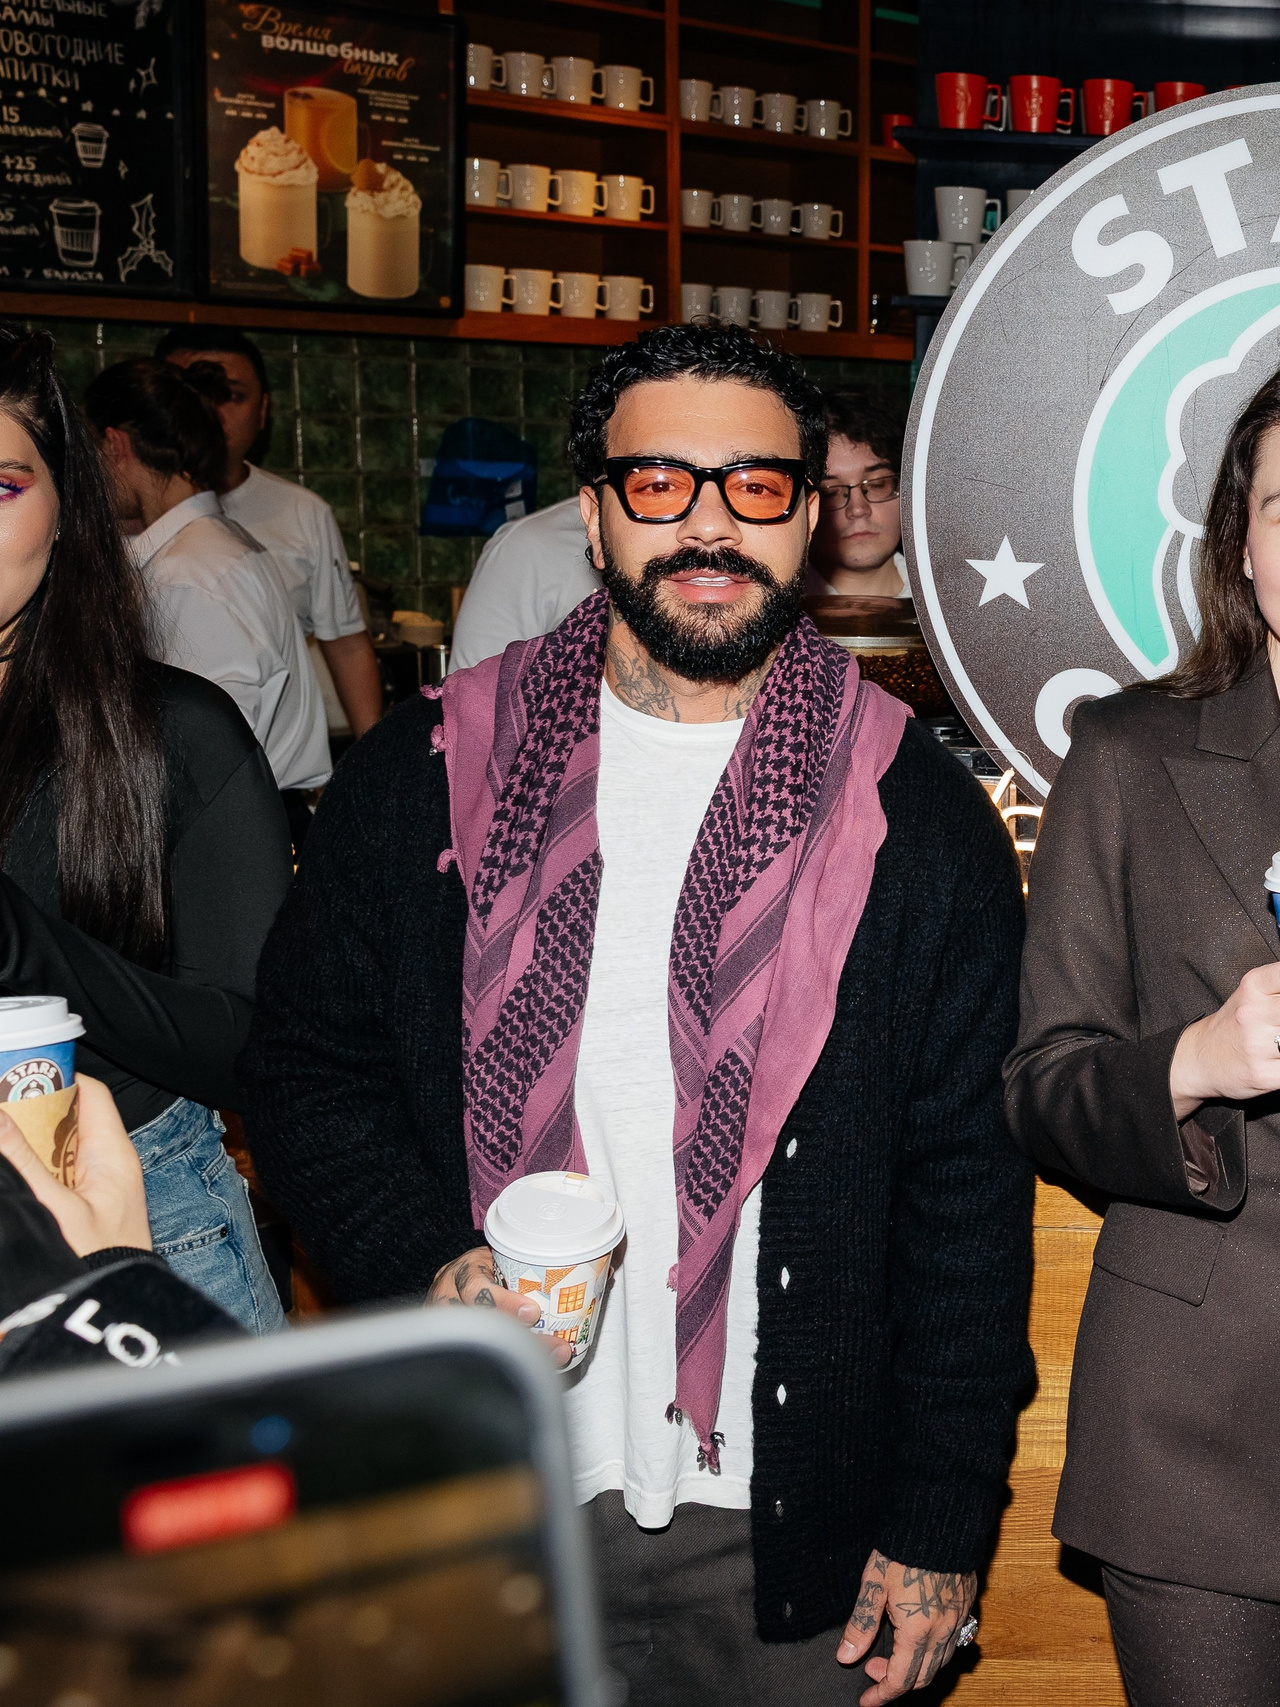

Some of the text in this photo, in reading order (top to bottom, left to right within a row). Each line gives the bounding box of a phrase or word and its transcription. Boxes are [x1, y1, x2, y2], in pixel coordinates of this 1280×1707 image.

[242, 4, 332, 40] Время
[261, 34, 400, 66] волшебных
[342, 57, 416, 86] вкусов
[2, 154, 37, 171] +25
[6, 1062, 58, 1085] STARS
